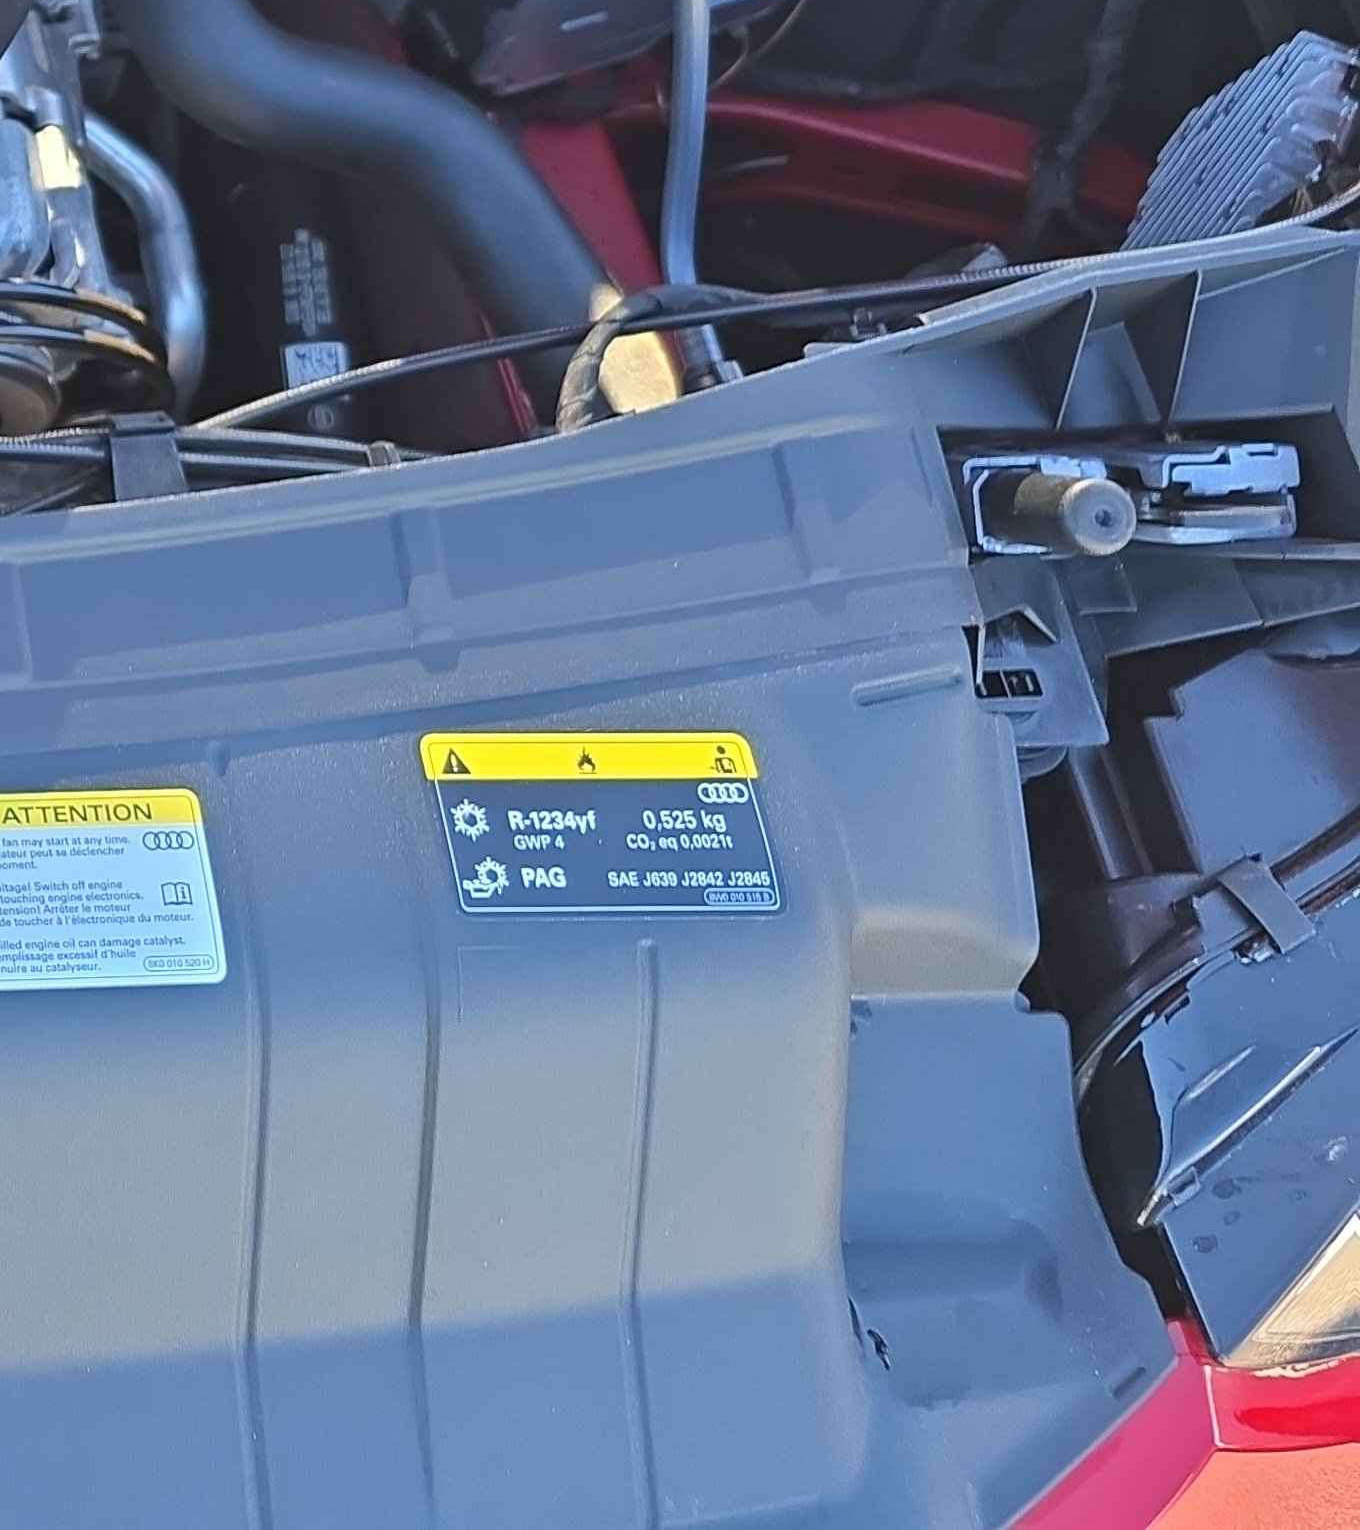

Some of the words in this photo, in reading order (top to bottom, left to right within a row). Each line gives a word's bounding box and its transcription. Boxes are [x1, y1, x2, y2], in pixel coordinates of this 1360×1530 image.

[2, 803, 153, 824] ATTENTION
[700, 809, 727, 833] kg
[507, 809, 596, 835] R-1234yf
[2, 837, 19, 847] fan
[21, 837, 43, 848] may
[46, 836, 69, 846] start
[71, 836, 82, 845] at
[84, 836, 102, 847] any
[105, 835, 130, 844] time.
[514, 834, 551, 851] GWP
[555, 834, 565, 850] 4
[658, 835, 678, 852] eq
[30, 848, 53, 859] peut
[55, 848, 67, 857] se
[69, 846, 125, 857] déclencher
[521, 866, 567, 888] PAG
[607, 871, 640, 888] SAE
[681, 871, 724, 887] J2842
[727, 871, 771, 887] J2845
[34, 881, 69, 891] Switch
[72, 880, 85, 890] off
[88, 880, 122, 891] engine
[0, 893, 45, 904] touching
[48, 892, 82, 903] engine
[85, 891, 143, 901] electronics.
[82, 903, 91, 913] le
[94, 903, 130, 912] moteur
[0, 917, 11, 927] de
[14, 916, 53, 927] toucher
[138, 913, 151, 923] du
[154, 912, 193, 923] moteur.
[25, 939, 60, 951] engine
[62, 938, 75, 948] oil
[78, 938, 96, 947] can
[99, 937, 140, 948] damage
[143, 935, 186, 947] catalyst.
[56, 949, 98, 960] excessif
[101, 948, 136, 959] d'huile
[0, 963, 27, 973] nuire
[30, 964, 43, 973] au
[46, 962, 101, 973] catalyseur.
[167, 958, 182, 968] 010
